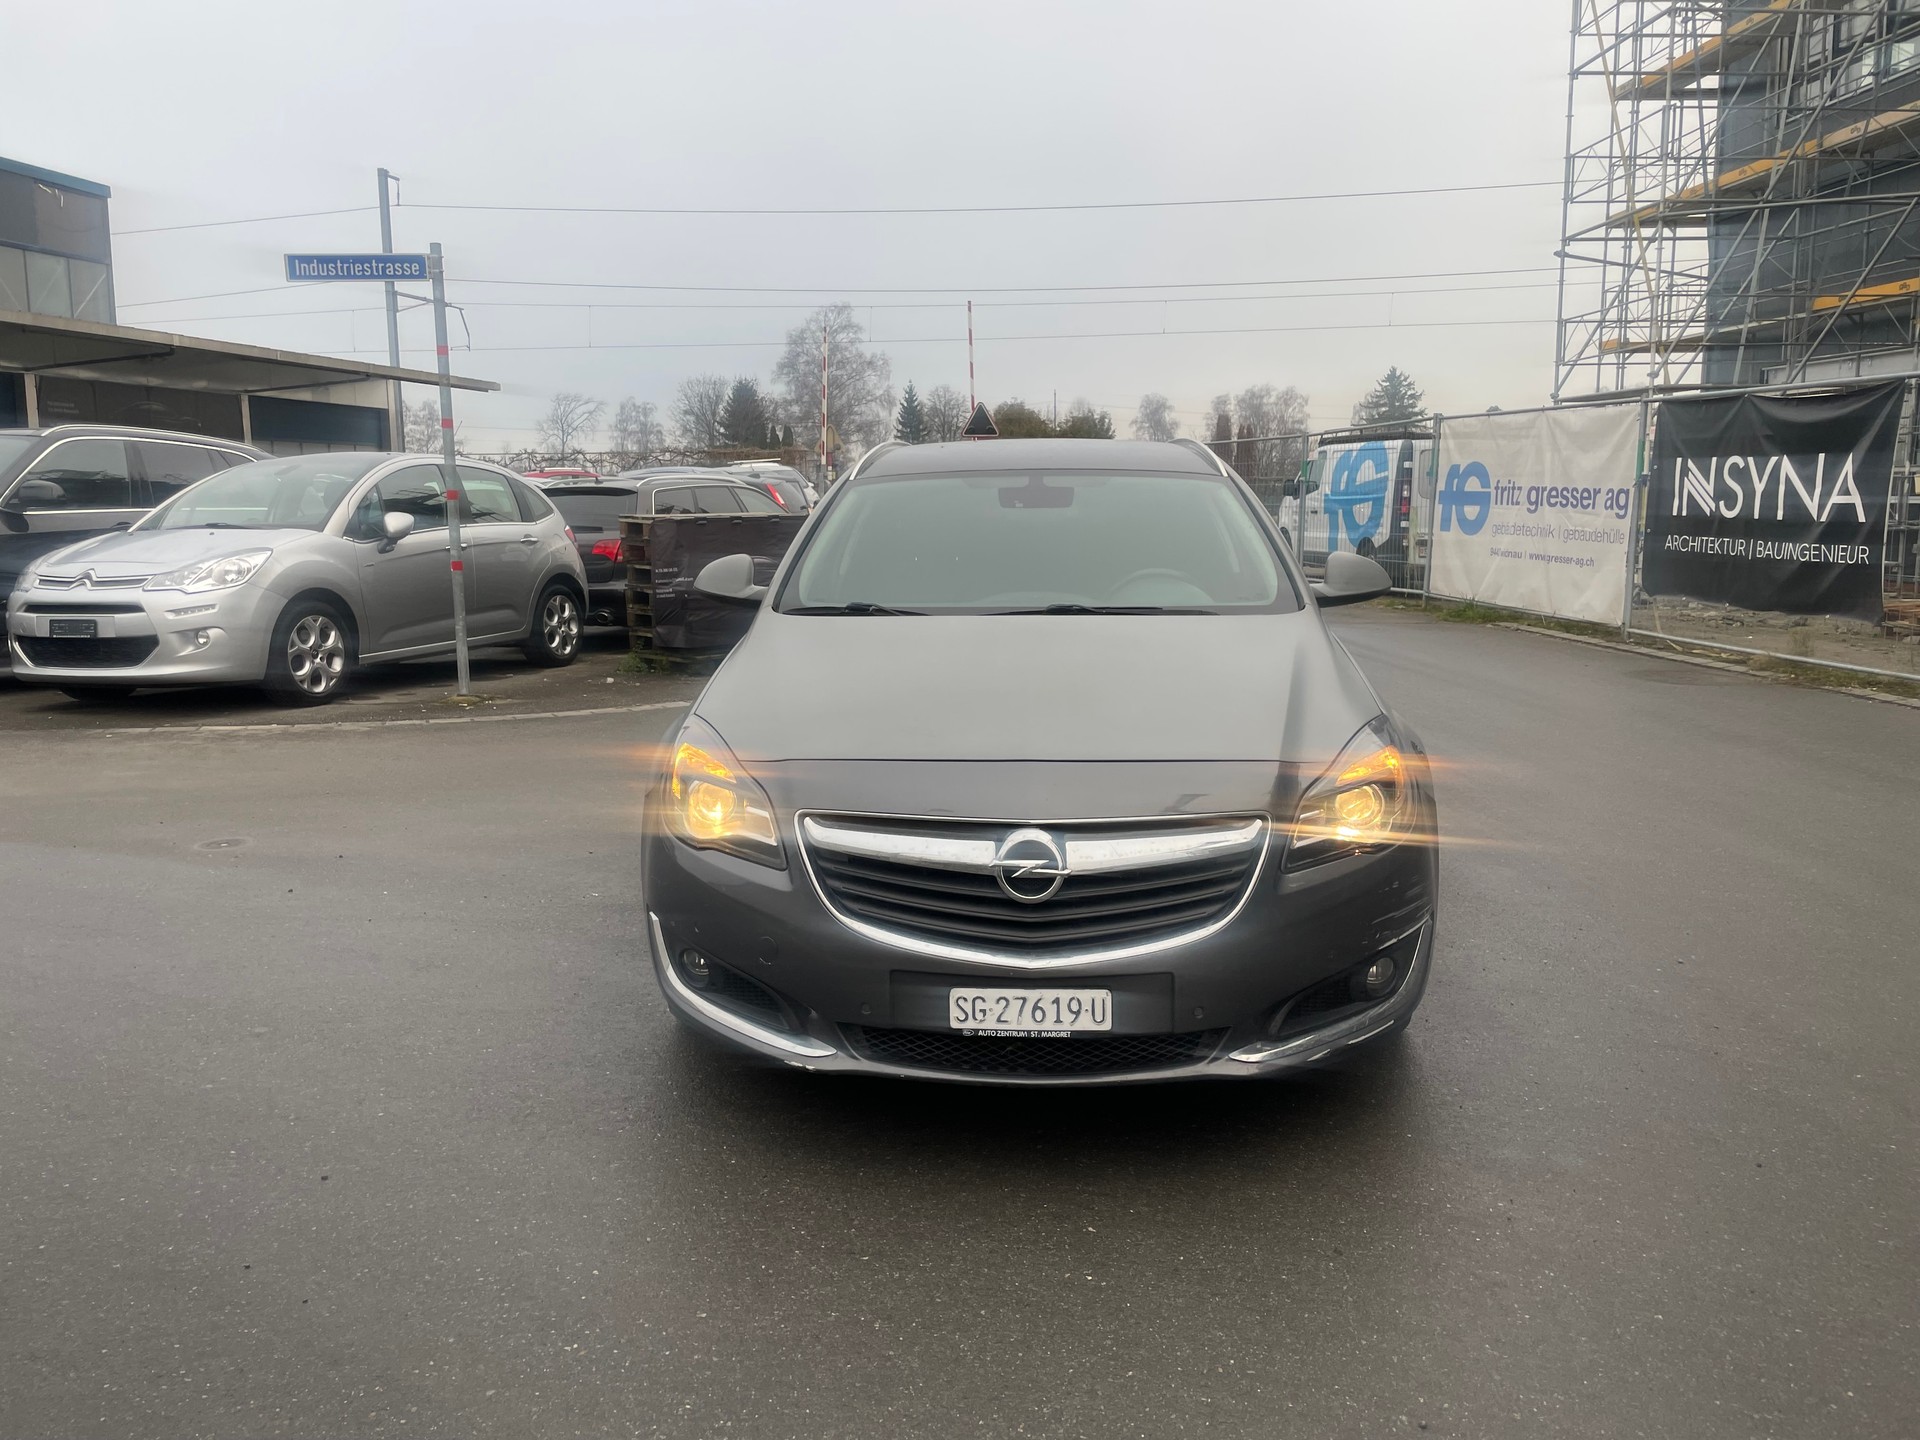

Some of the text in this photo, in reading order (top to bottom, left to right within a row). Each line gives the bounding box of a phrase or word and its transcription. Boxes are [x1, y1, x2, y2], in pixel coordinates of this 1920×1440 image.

[295, 259, 420, 276] Industriestrasse
[1493, 479, 1630, 519] fritz gresser ag
[1672, 452, 1866, 523] INSYNA
[1664, 534, 1870, 565] ARCHITEKTUR BAUINGENIEUR
